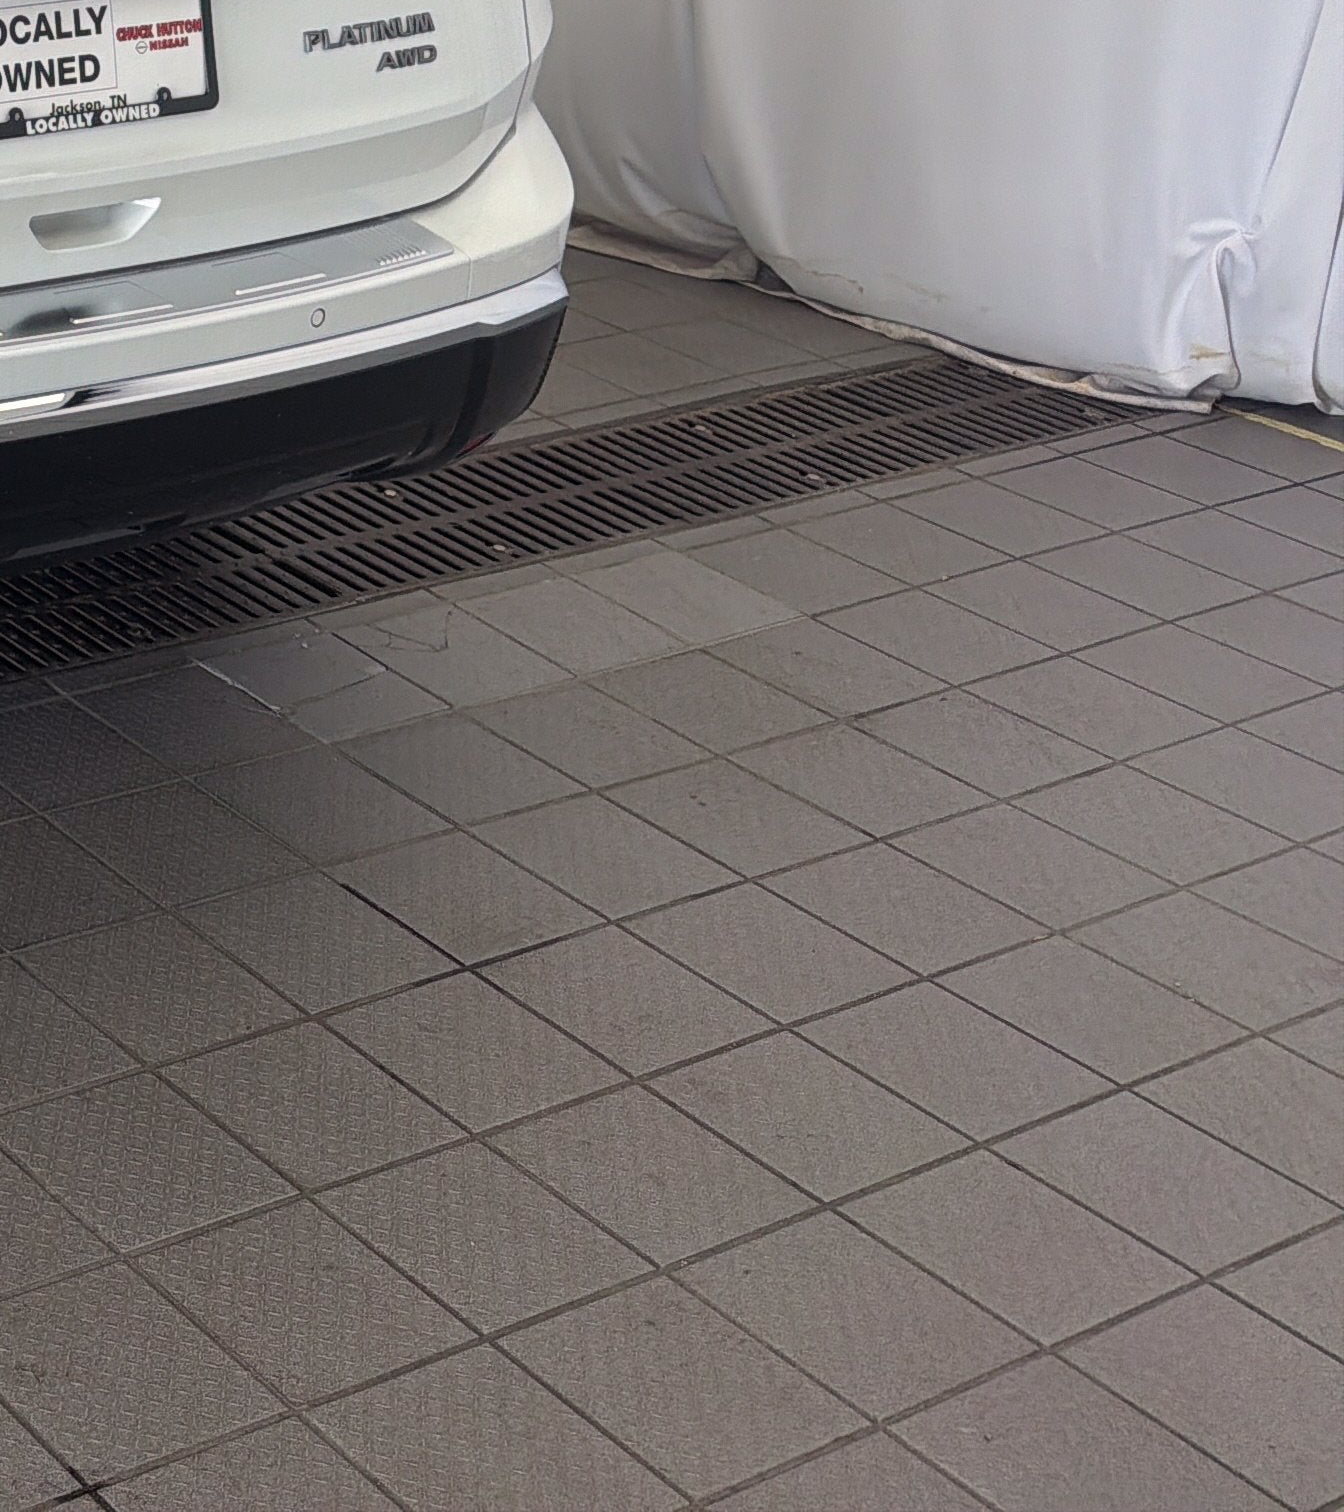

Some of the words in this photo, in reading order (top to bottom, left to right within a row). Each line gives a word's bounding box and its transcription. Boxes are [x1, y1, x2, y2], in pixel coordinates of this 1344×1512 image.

[116, 23, 154, 42] CHUCK
[156, 18, 203, 38] HUTTON
[303, 12, 435, 53] PLATINUM
[149, 37, 189, 51] NISSAN
[376, 44, 437, 72] AWD
[50, 99, 105, 116] Jackson,
[109, 93, 127, 108] TN
[25, 112, 94, 135] LOCALLY
[100, 103, 160, 124] OWNED
